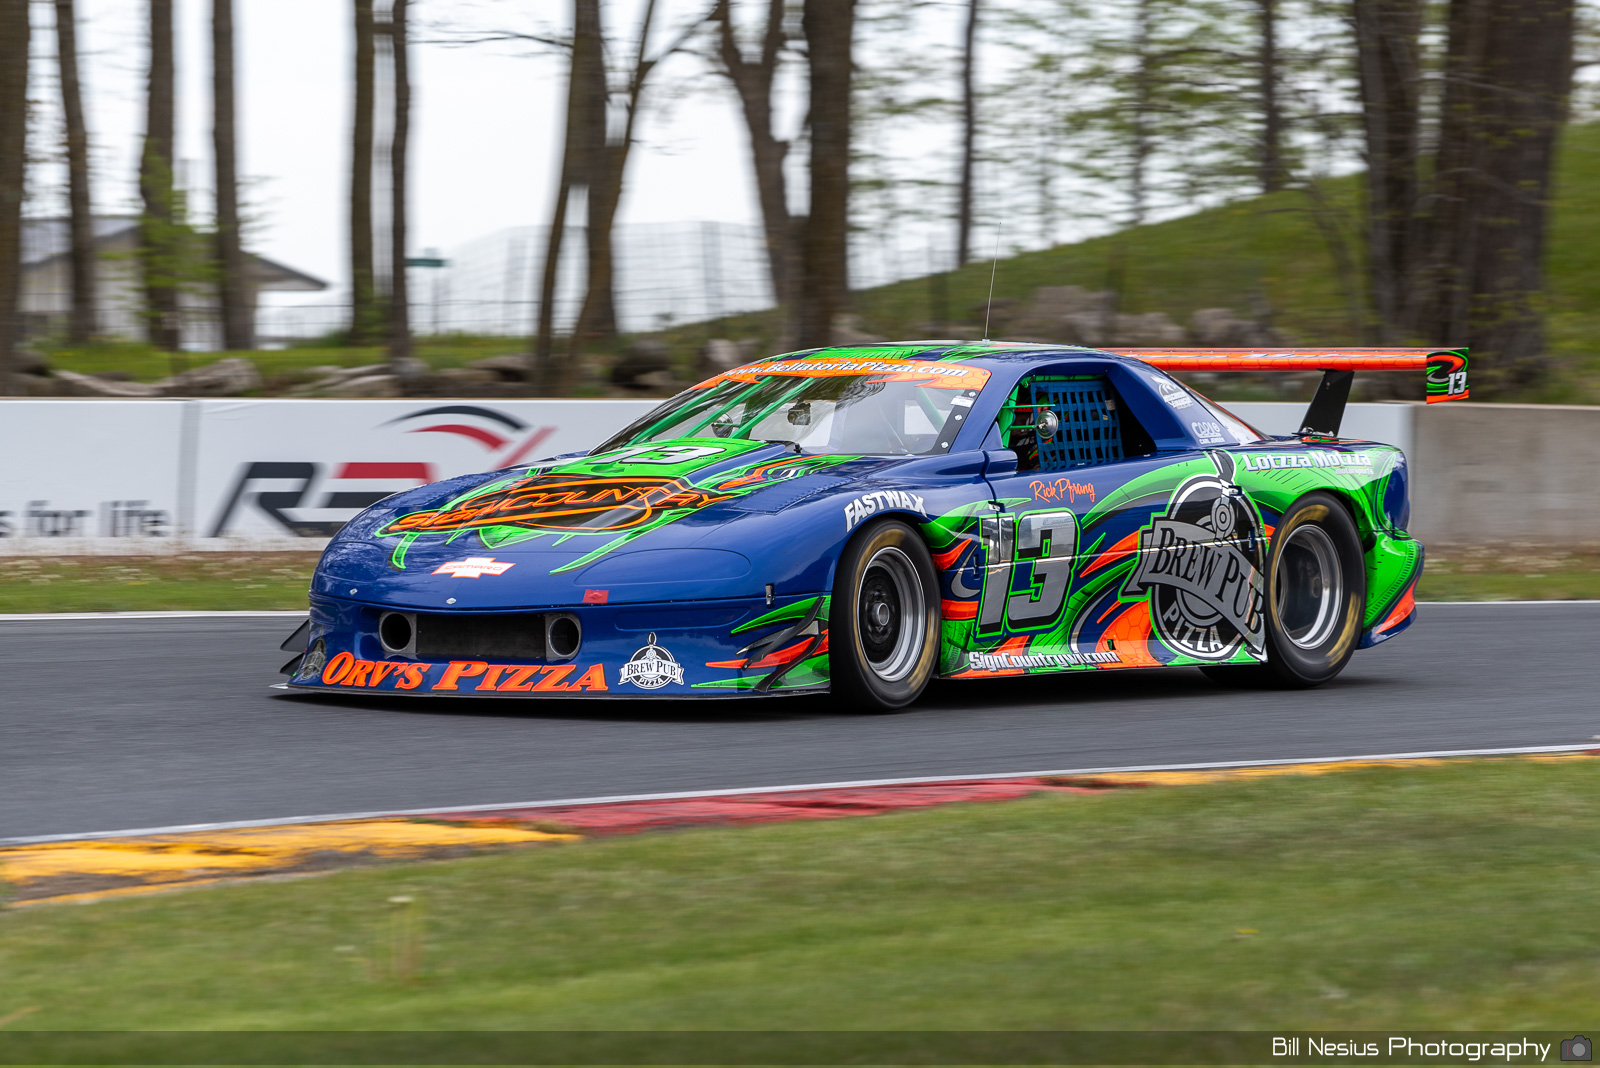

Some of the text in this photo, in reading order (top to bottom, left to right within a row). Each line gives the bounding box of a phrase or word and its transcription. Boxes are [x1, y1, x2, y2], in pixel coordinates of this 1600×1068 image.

[725, 361, 969, 377] www.BellatoriaPizza.com
[1448, 371, 1467, 395] 13
[585, 446, 726, 465] 13
[1241, 450, 1373, 472] Lotzza Motzza
[1029, 478, 1096, 504] Rick Pfrang
[26, 500, 94, 538] for
[98, 500, 171, 538] life
[843, 490, 929, 534] FASTWAX
[978, 510, 1077, 635] 13
[1150, 527, 1264, 634] BREW PUB
[1162, 600, 1223, 652] PIZZA
[321, 651, 431, 690] ORV'S
[432, 660, 609, 693] PIZZA
[627, 660, 676, 676] BREW PUB
